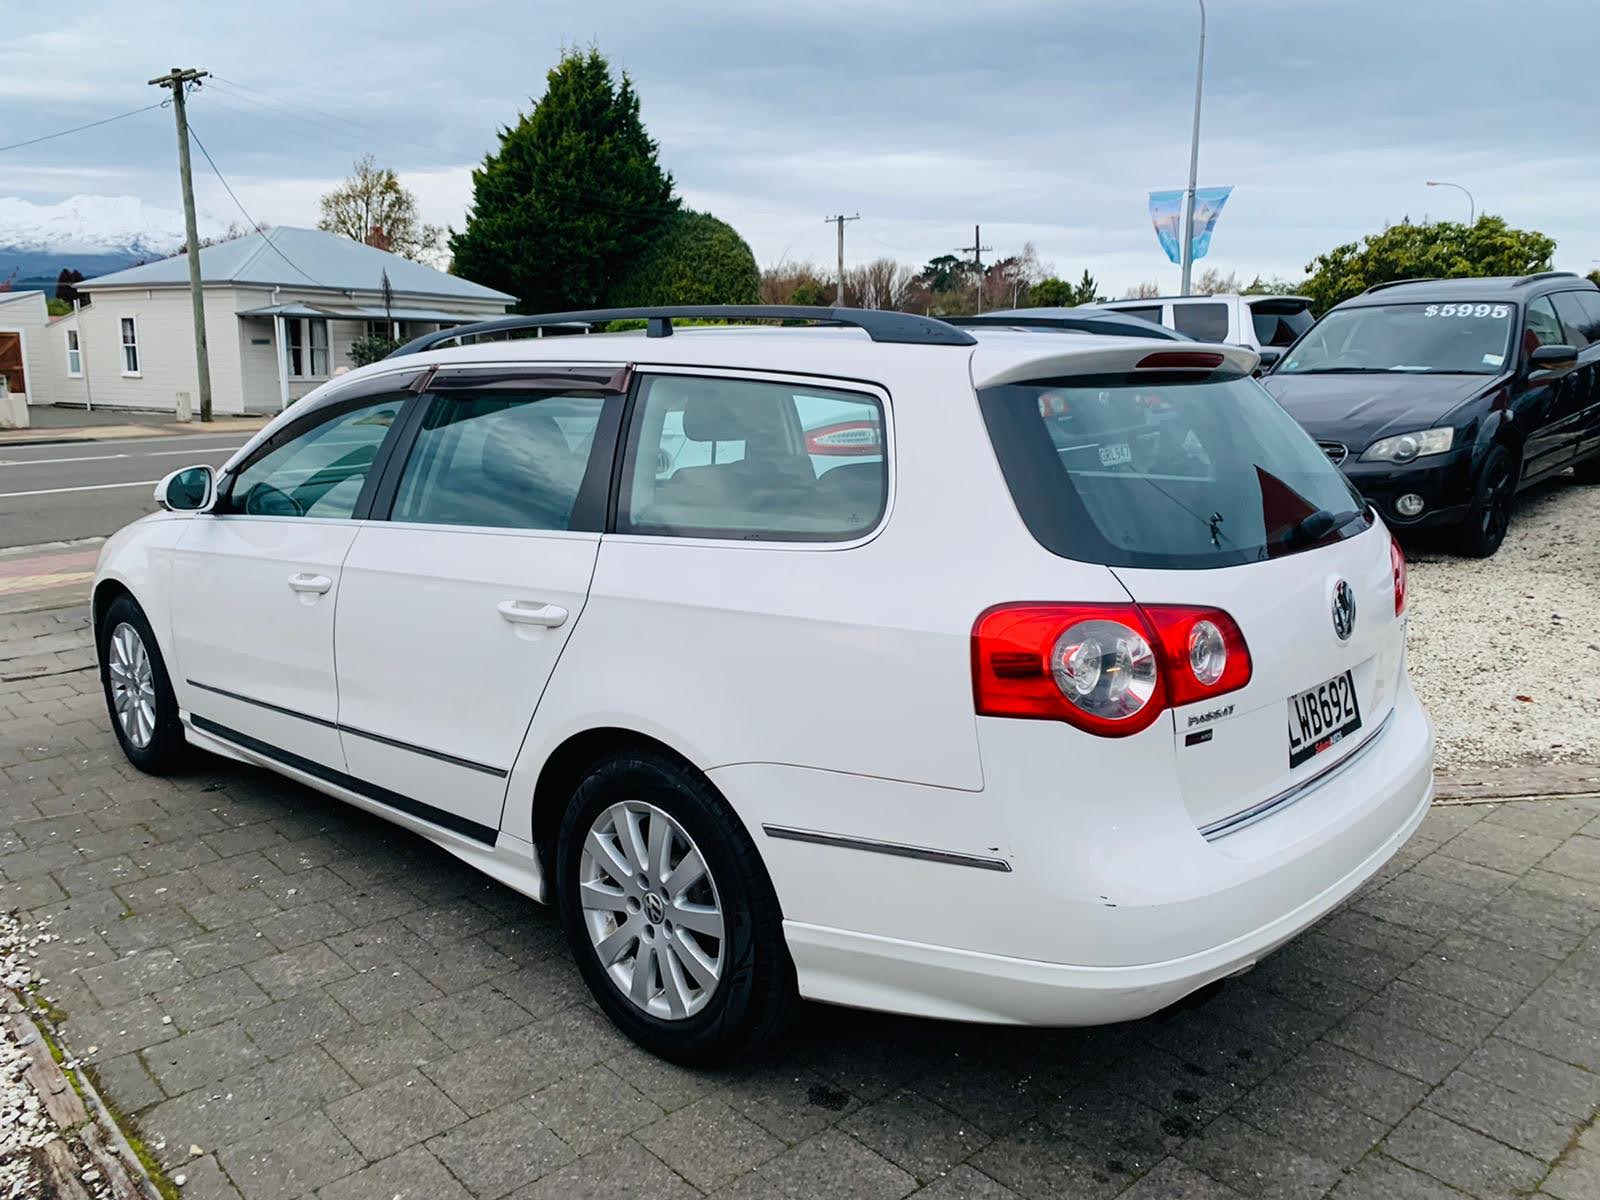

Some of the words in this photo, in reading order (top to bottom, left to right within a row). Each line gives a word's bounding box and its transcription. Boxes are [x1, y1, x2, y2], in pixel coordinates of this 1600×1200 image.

[1425, 304, 1509, 318] $5995
[1188, 704, 1235, 727] PASSAT
[1288, 676, 1354, 749] LWB692
